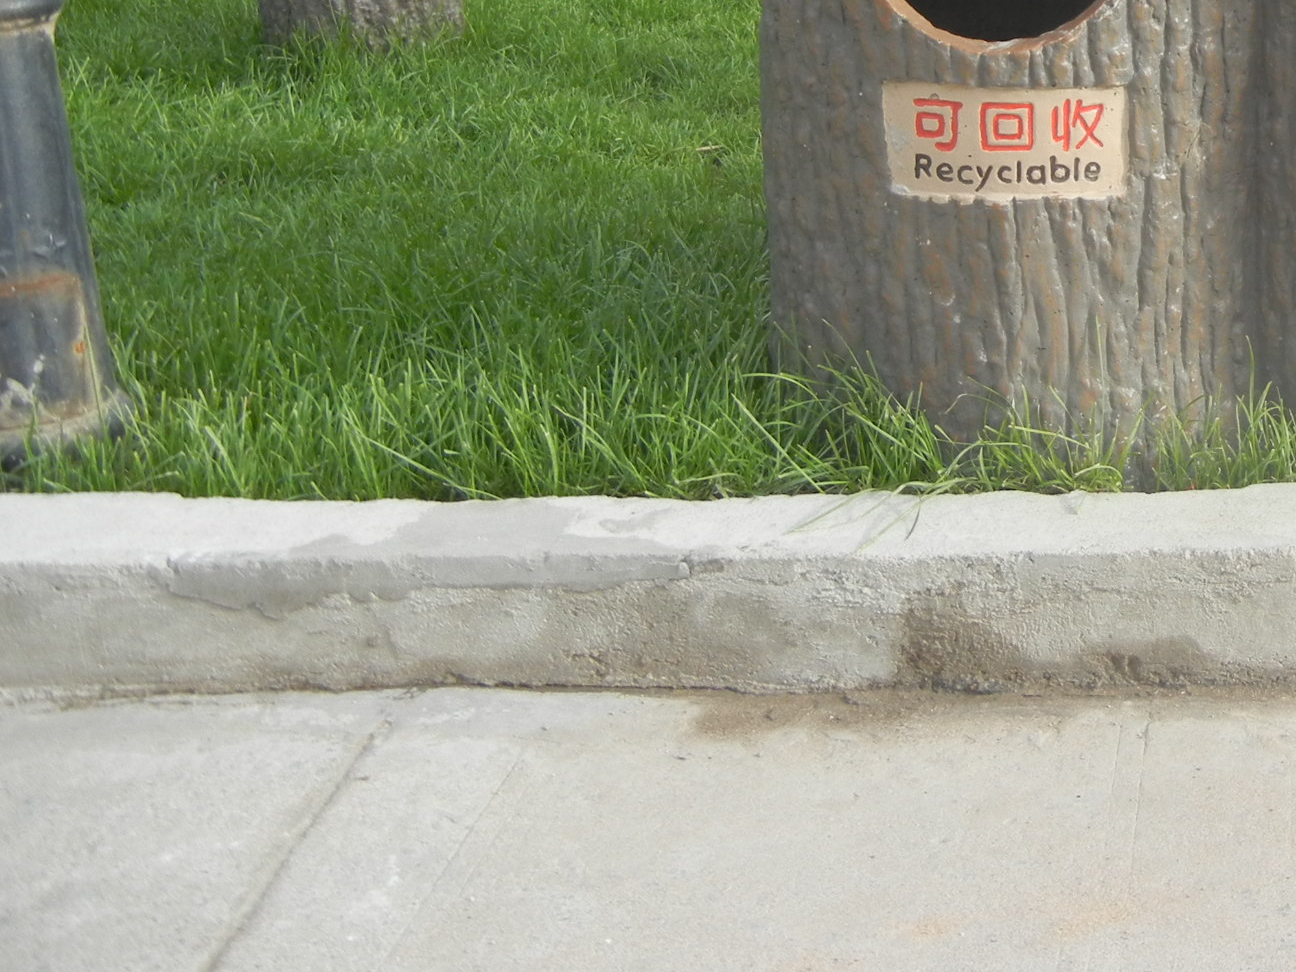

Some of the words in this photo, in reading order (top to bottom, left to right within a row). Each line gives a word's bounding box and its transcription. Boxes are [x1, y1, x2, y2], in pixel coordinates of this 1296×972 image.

[913, 98, 1104, 152] 可回收
[914, 153, 1101, 192] Recyclable
